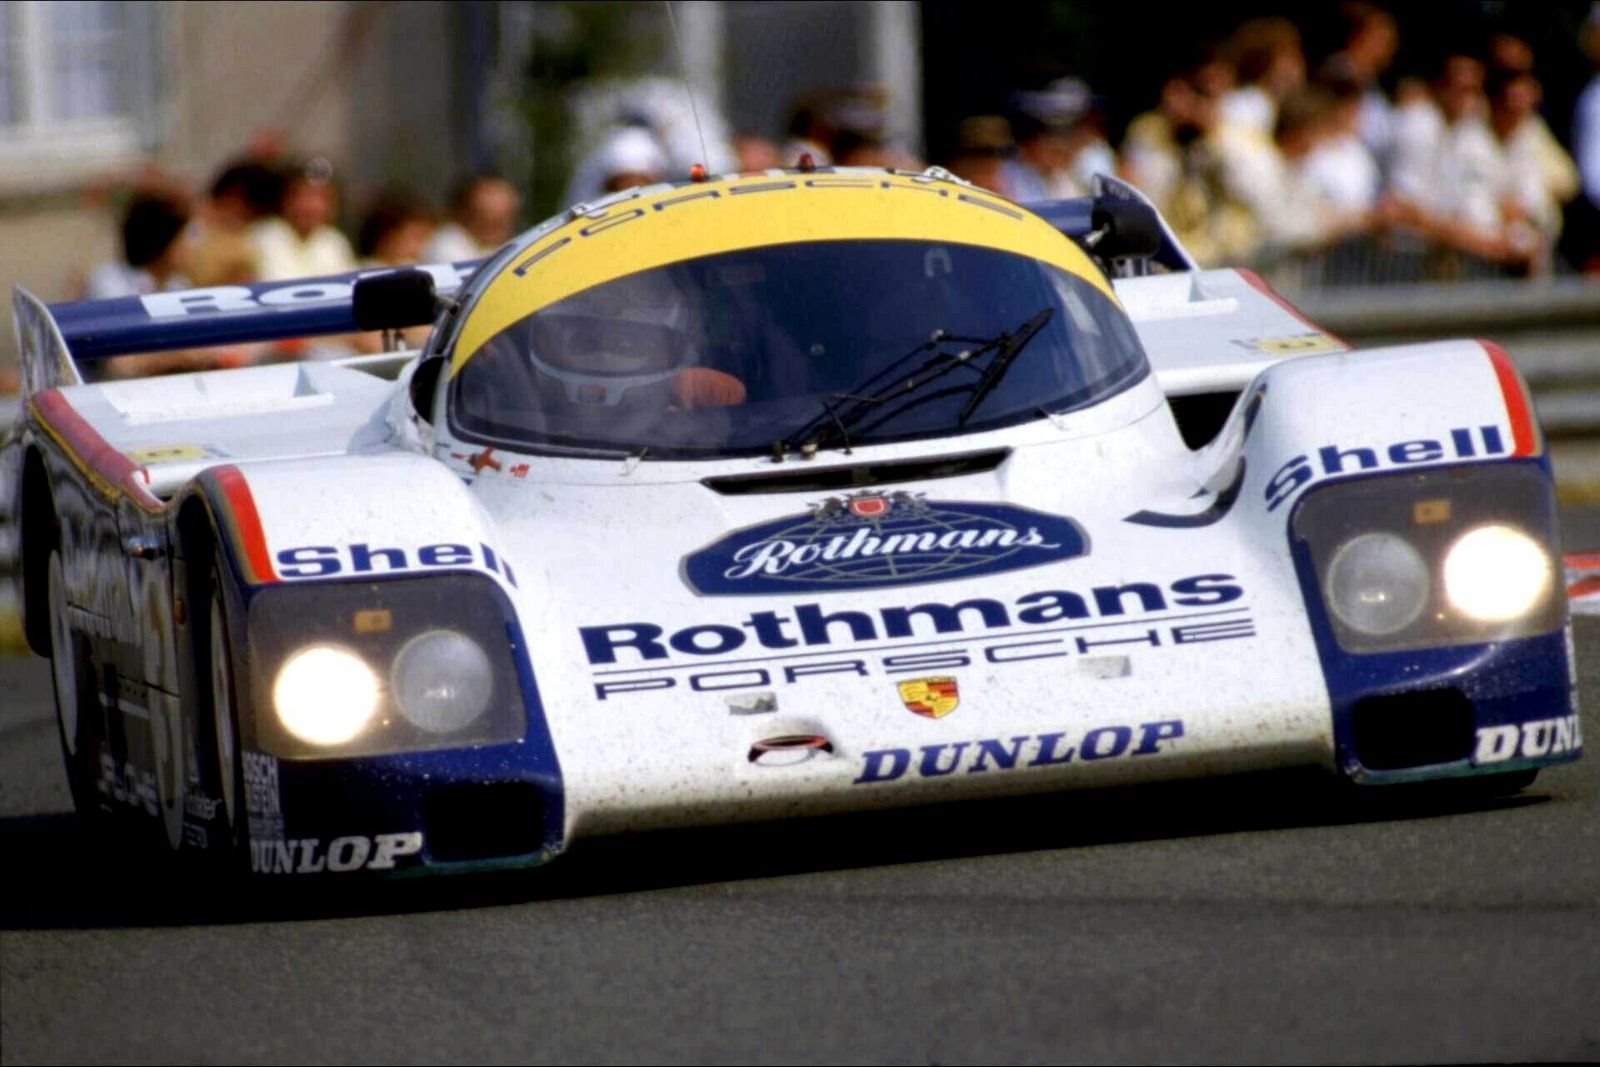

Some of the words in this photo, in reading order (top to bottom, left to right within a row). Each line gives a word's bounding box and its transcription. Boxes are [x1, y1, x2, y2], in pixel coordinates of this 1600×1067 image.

[513, 178, 1024, 277] PORSCHE
[1265, 425, 1505, 512] Shell
[277, 542, 518, 589] Shell
[724, 525, 1061, 579] Rothmans
[579, 573, 1244, 665] Rothmans
[594, 618, 1257, 701] PORSCHE
[852, 719, 1185, 785] DUNLOP
